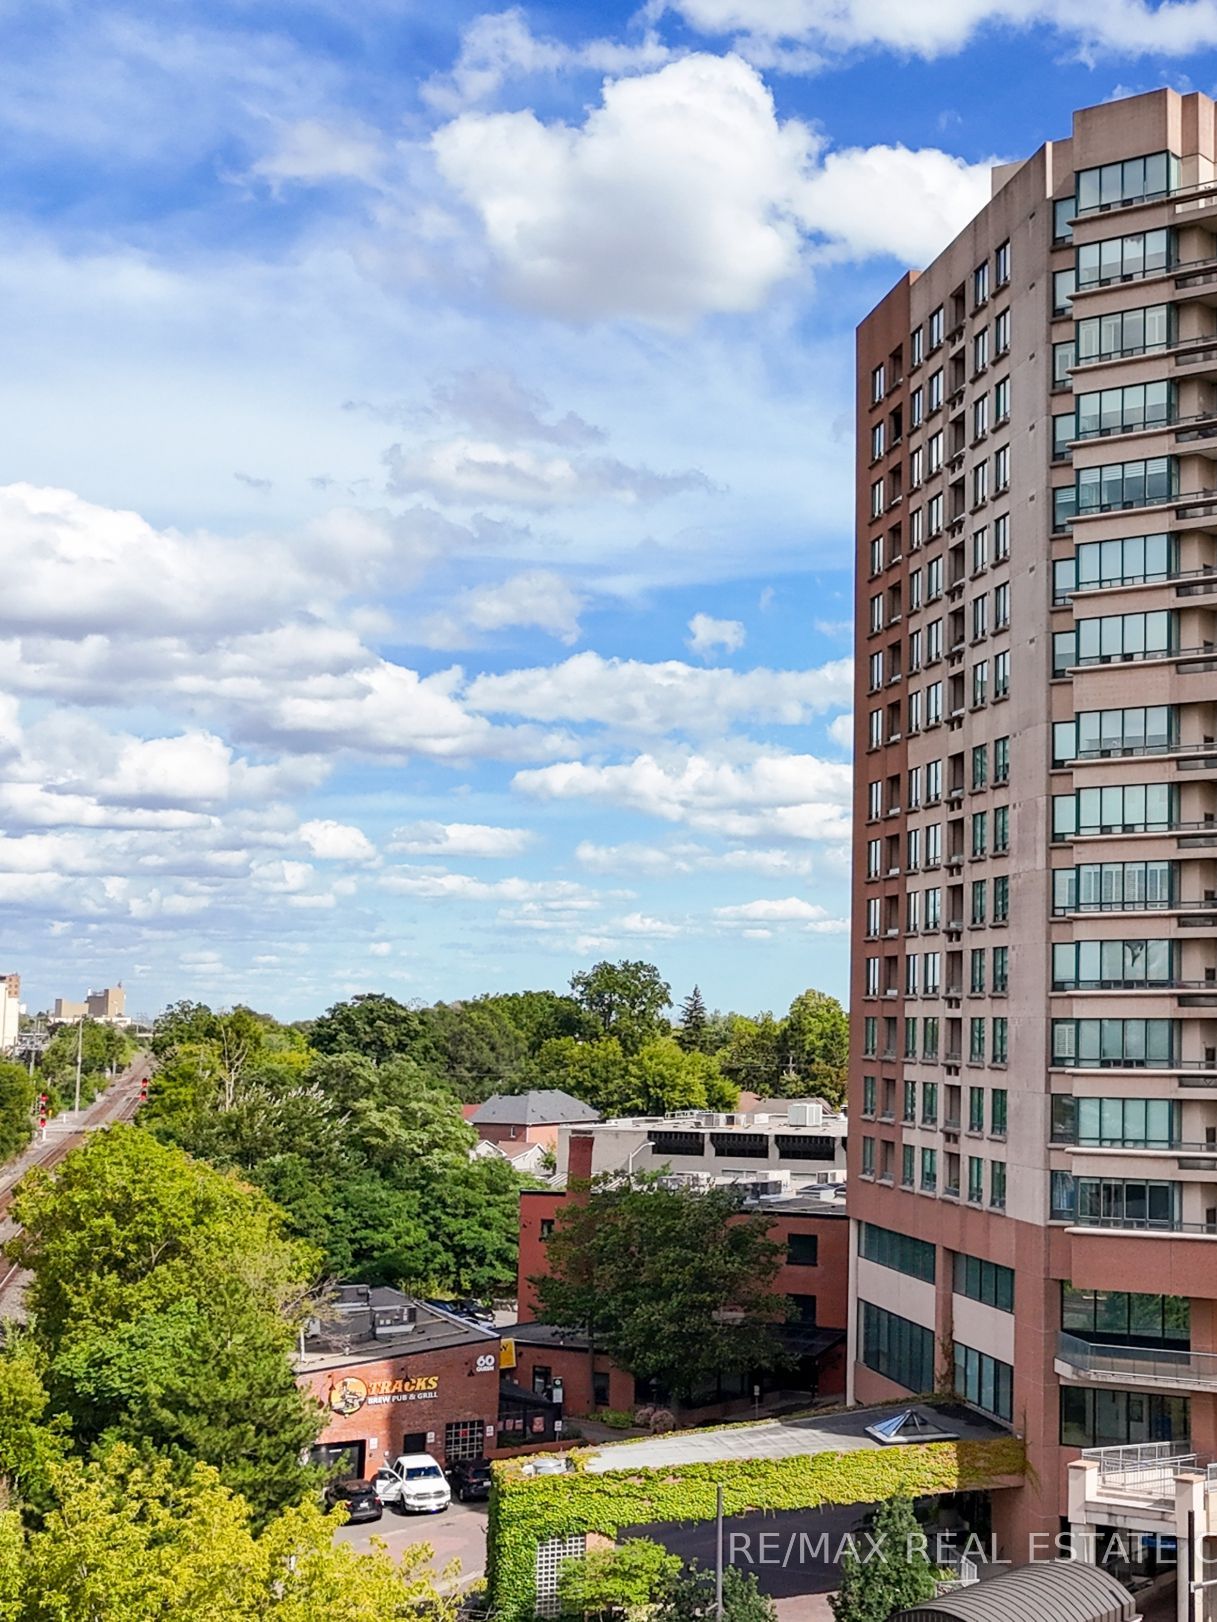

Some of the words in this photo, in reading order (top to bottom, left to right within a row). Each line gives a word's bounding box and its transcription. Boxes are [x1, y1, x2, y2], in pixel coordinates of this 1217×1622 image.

[476, 1354, 495, 1367] 60
[367, 1376, 439, 1396] TRACKS
[367, 1394, 391, 1405] BREW
[392, 1393, 407, 1402] PUB
[417, 1391, 438, 1400] GRILL
